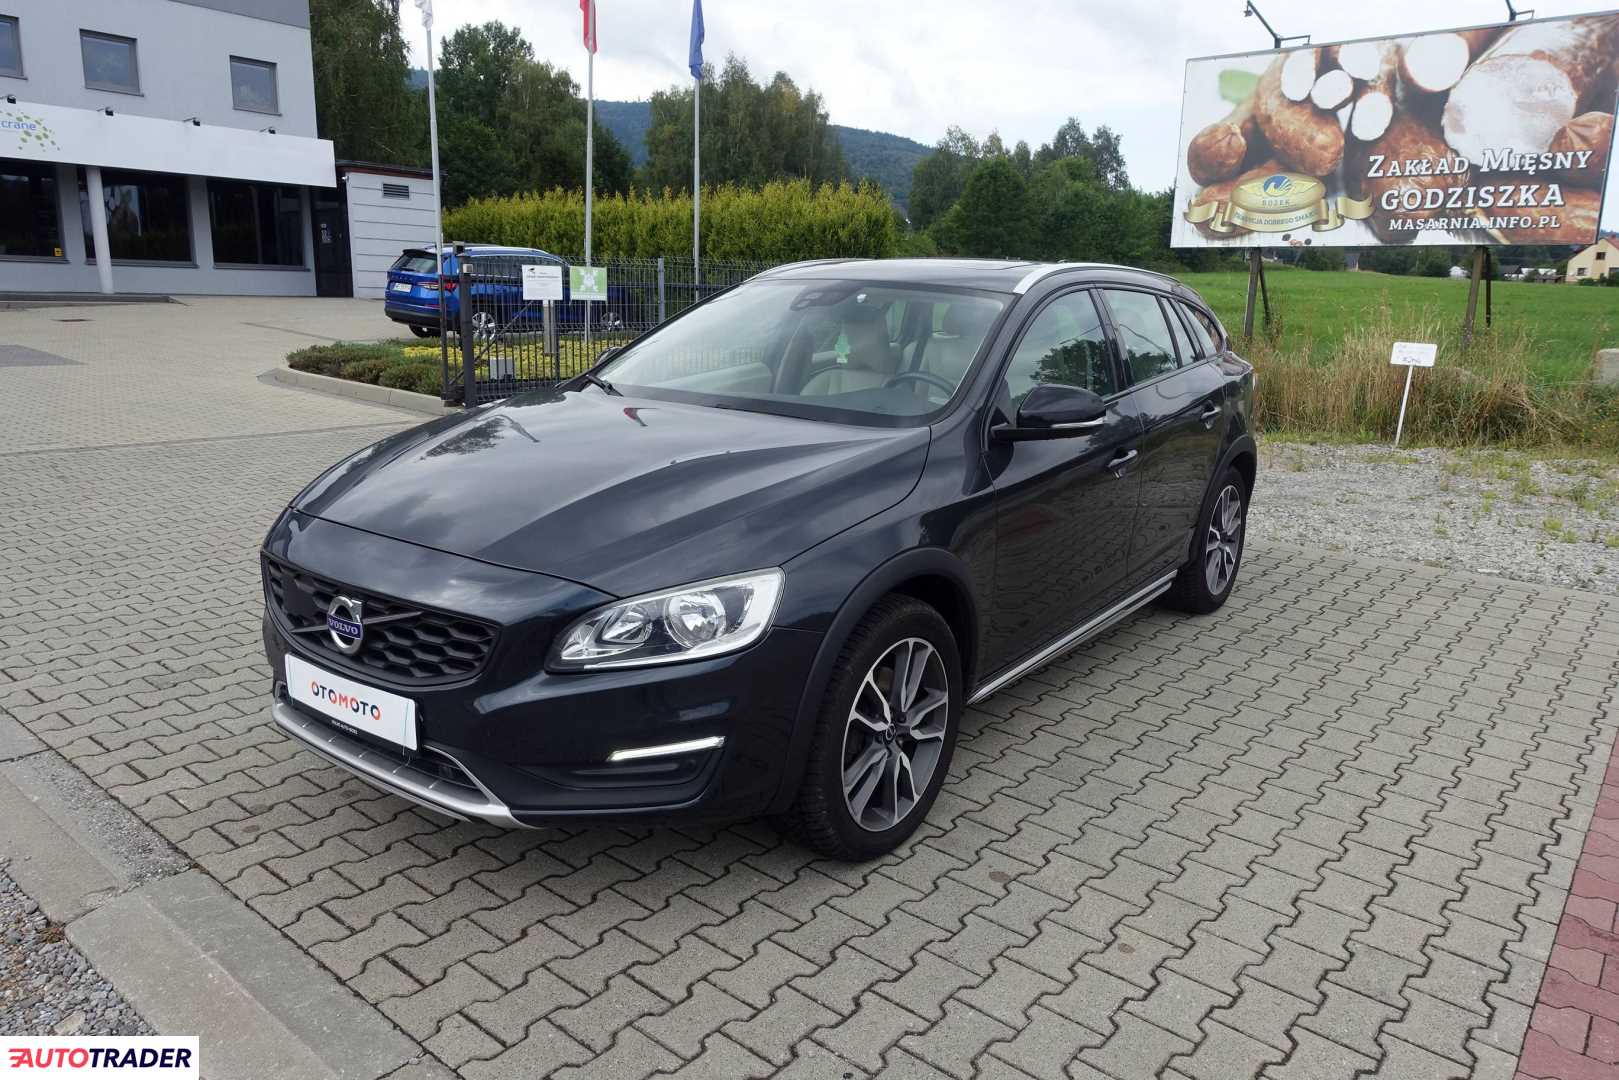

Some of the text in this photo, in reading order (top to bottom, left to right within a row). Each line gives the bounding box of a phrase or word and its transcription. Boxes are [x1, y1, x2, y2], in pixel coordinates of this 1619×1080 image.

[1, 120, 37, 131] crane
[1381, 183, 1565, 210] GODZISZKA
[1389, 216, 1561, 231] MASARNIA.INFO.PL
[328, 617, 359, 635] VOLVO
[311, 680, 381, 721] OTOMOTO
